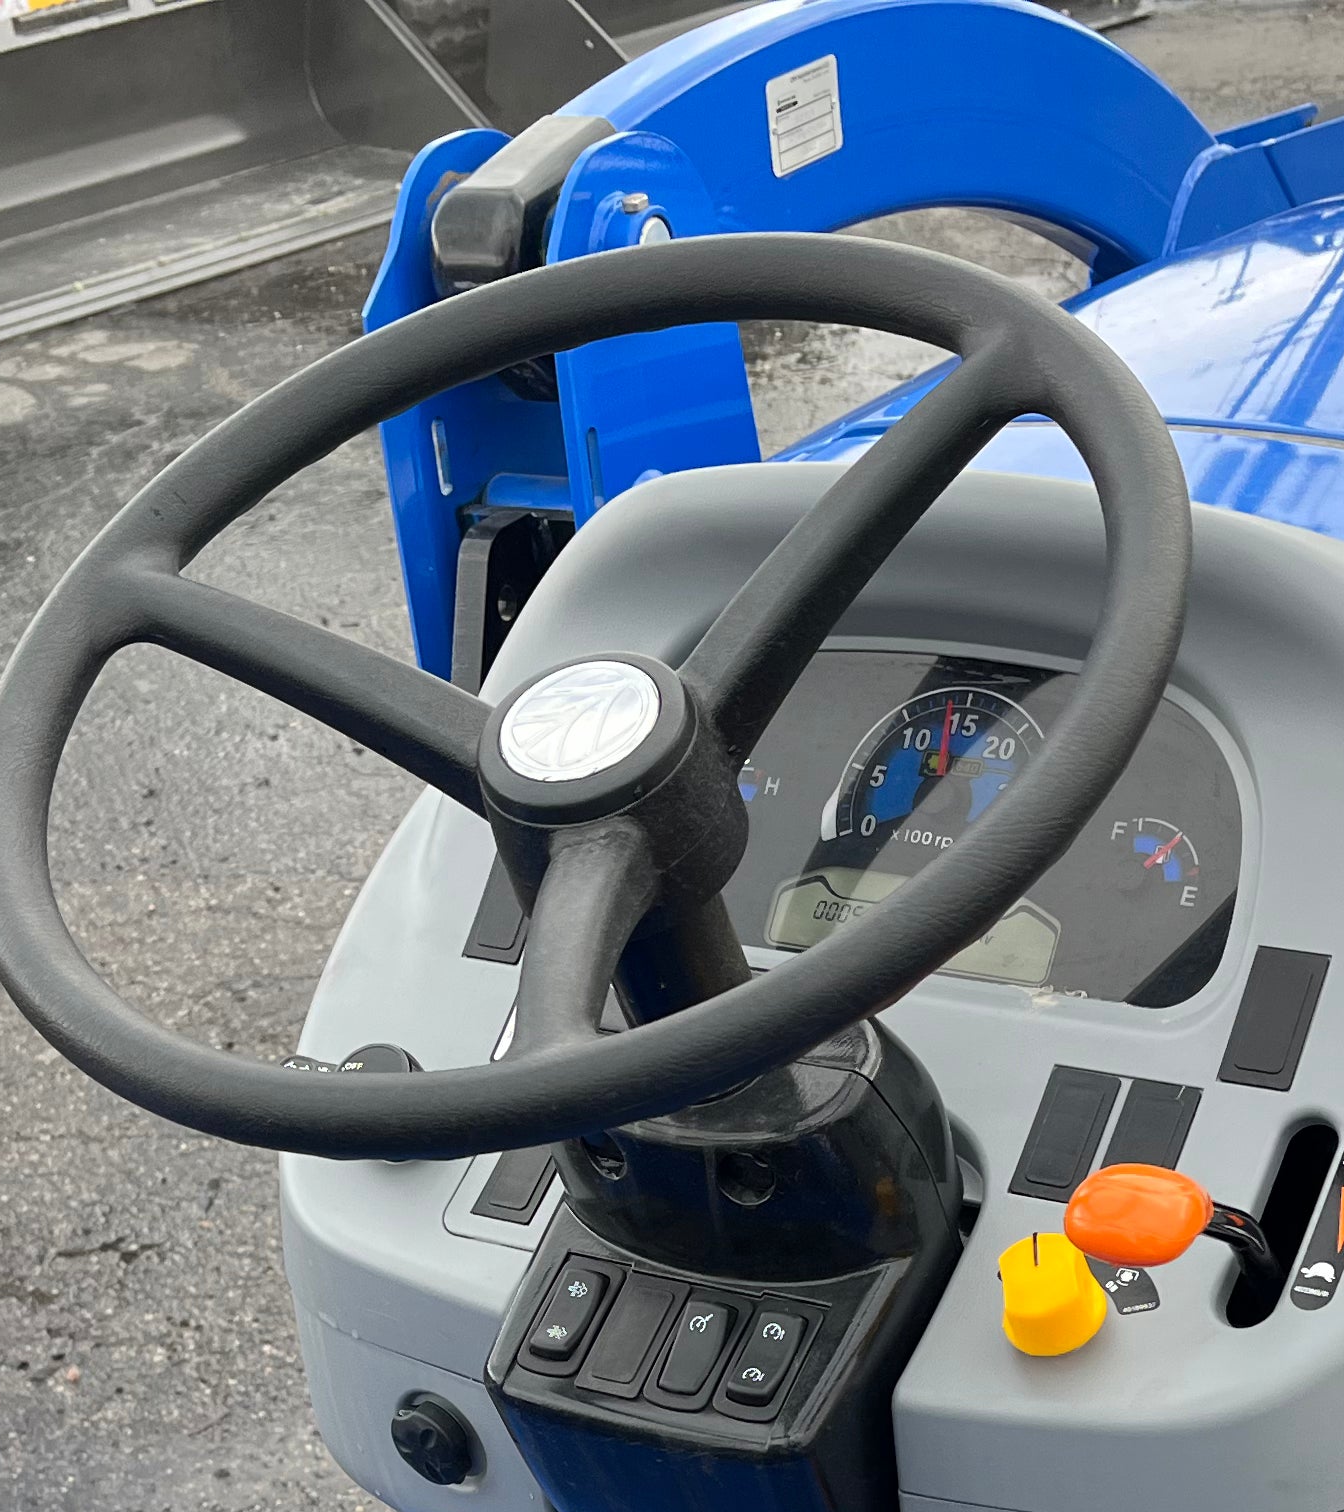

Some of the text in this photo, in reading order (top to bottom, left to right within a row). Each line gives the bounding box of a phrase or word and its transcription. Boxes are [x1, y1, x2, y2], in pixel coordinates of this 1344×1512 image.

[949, 713, 980, 738] 15
[902, 727, 931, 751] 10
[982, 736, 1016, 761] 20
[764, 776, 781, 796] H
[869, 765, 888, 788] 5
[860, 814, 877, 837] 0
[1111, 821, 1128, 840] F
[1179, 885, 1198, 907] E
